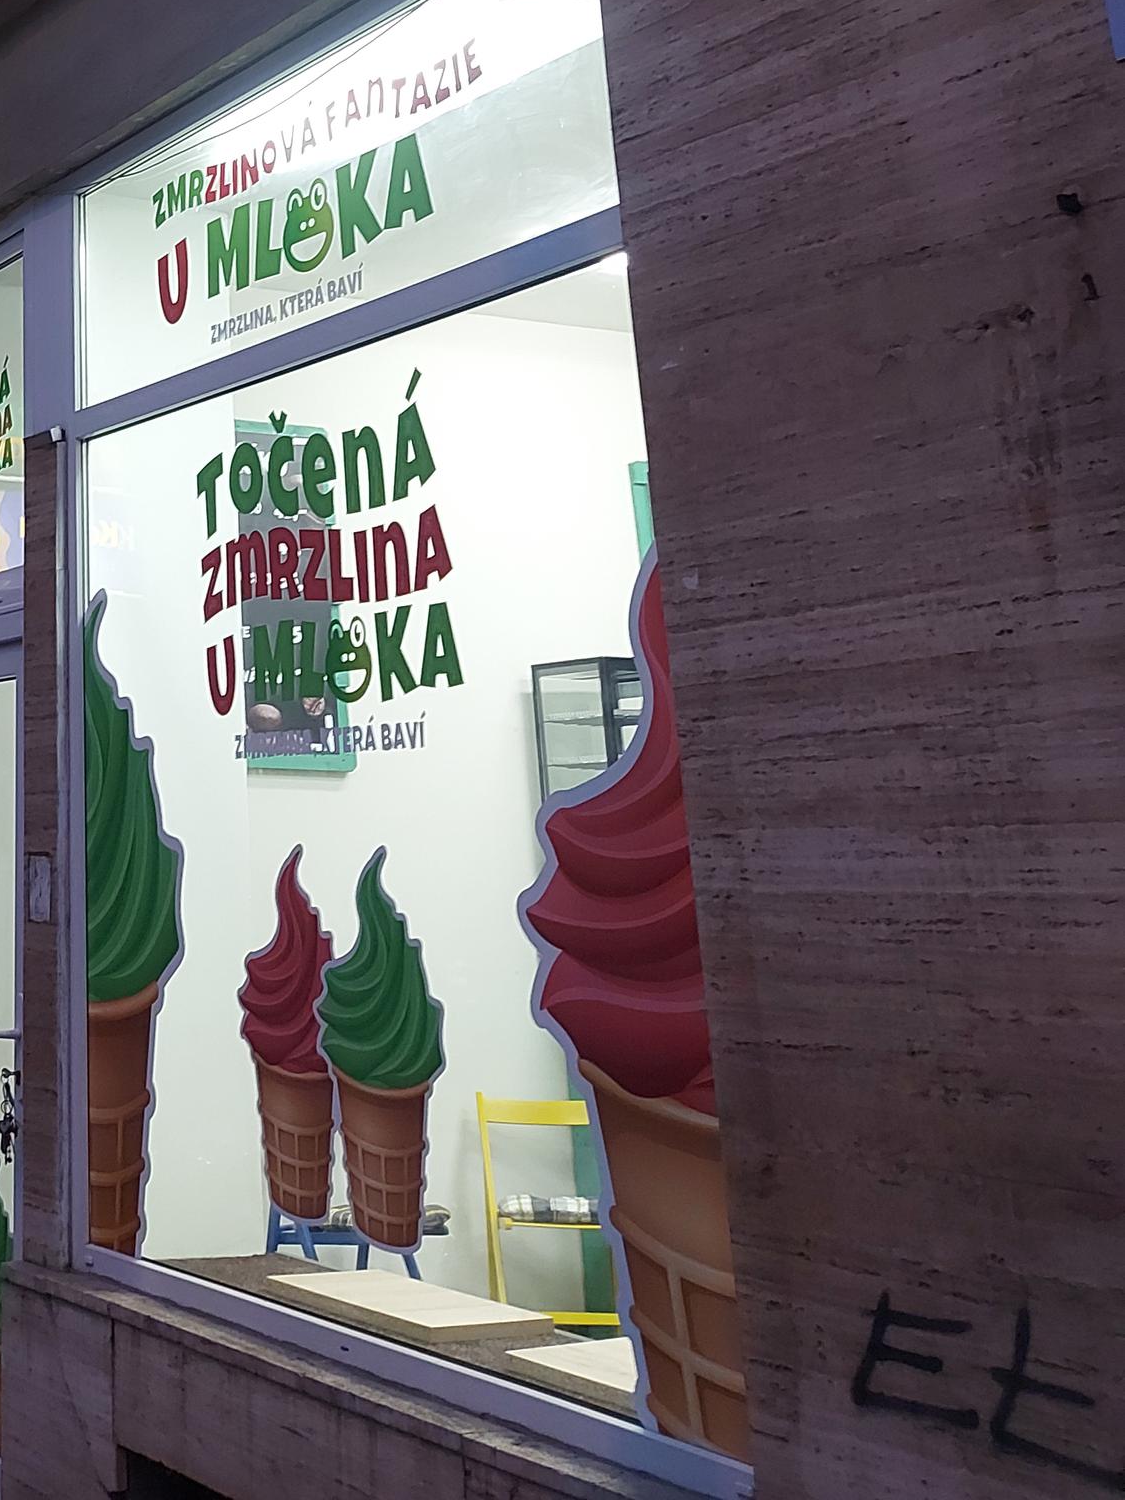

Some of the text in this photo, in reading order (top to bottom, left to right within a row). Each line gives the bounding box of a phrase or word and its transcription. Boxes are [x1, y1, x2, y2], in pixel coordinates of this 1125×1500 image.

[327, 38, 483, 141] FANTAZIE
[157, 238, 189, 325] U
[279, 279, 324, 323] KTERÁ
[328, 261, 363, 303] BAVÍ
[206, 635, 236, 716] U
[381, 711, 426, 751] BAVÍ
